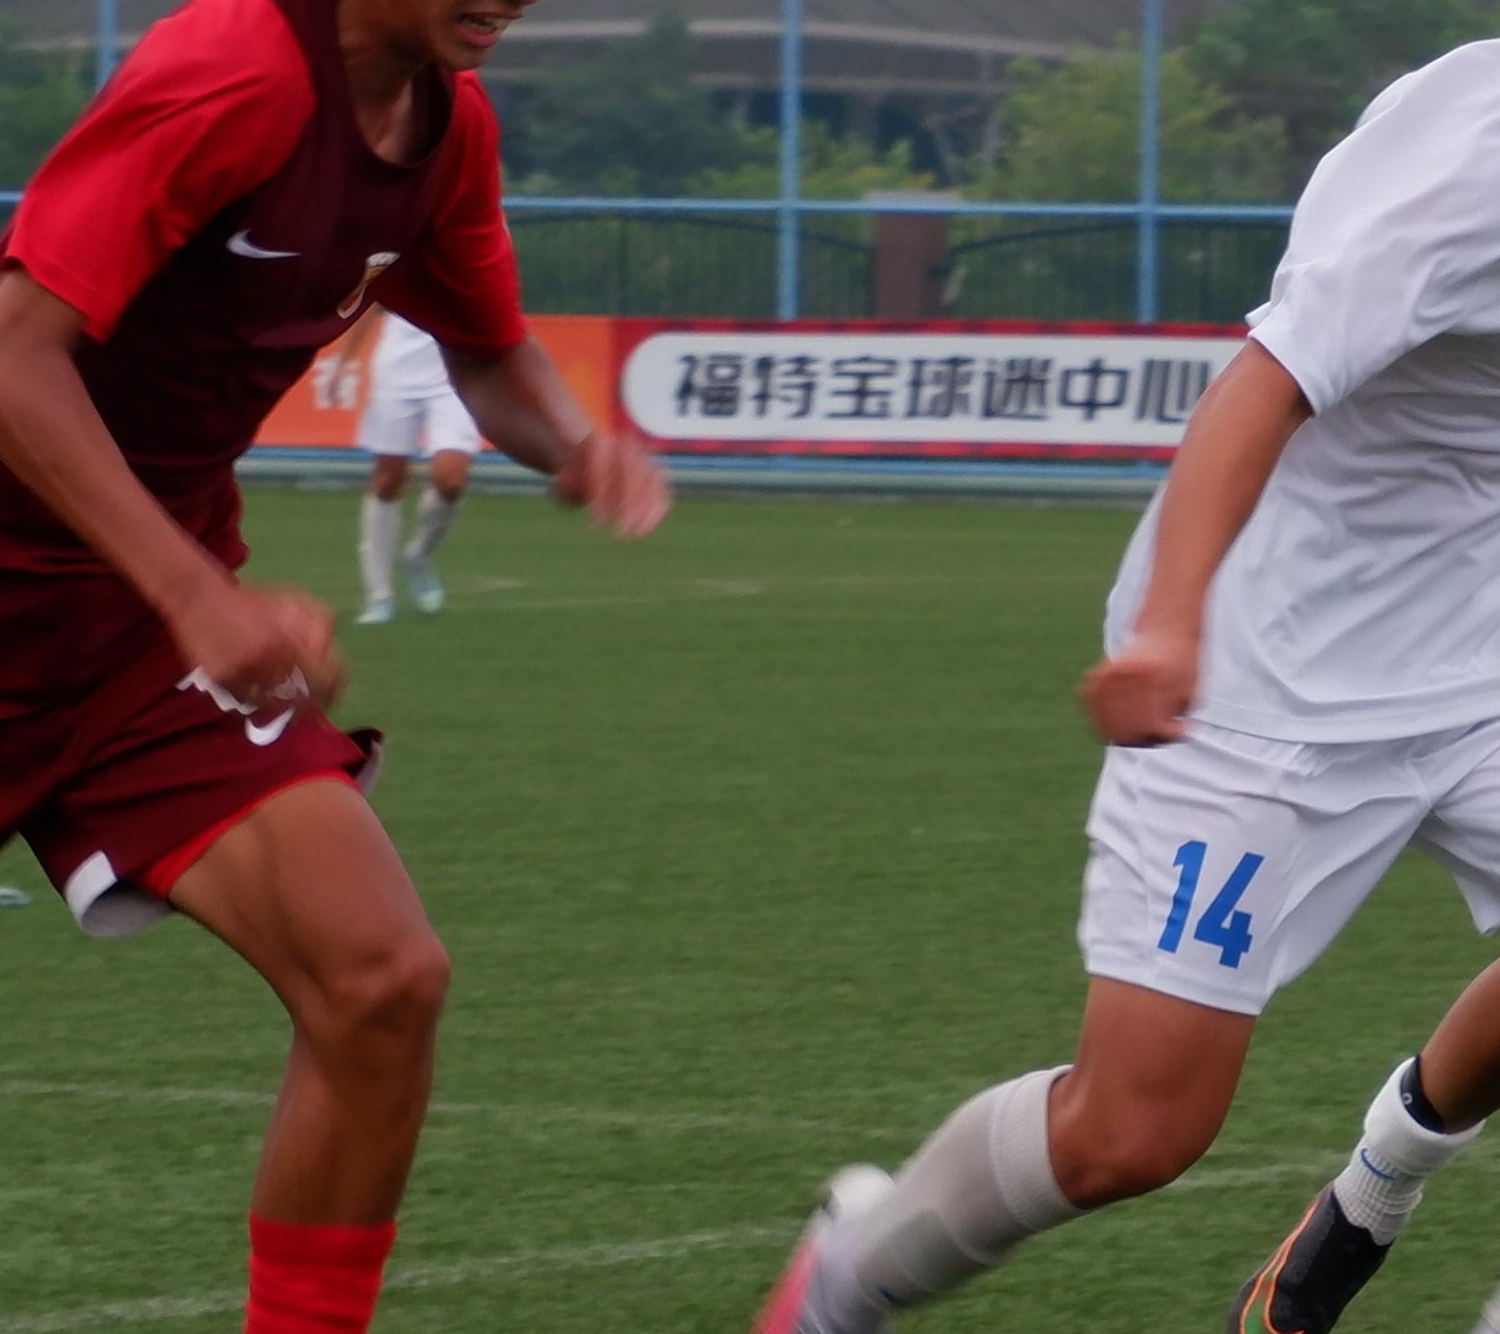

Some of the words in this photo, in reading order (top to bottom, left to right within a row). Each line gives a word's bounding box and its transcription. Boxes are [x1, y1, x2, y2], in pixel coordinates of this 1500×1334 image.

[675, 354, 1209, 423] 福特宝球迷中心
[1157, 839, 1265, 969] 14
